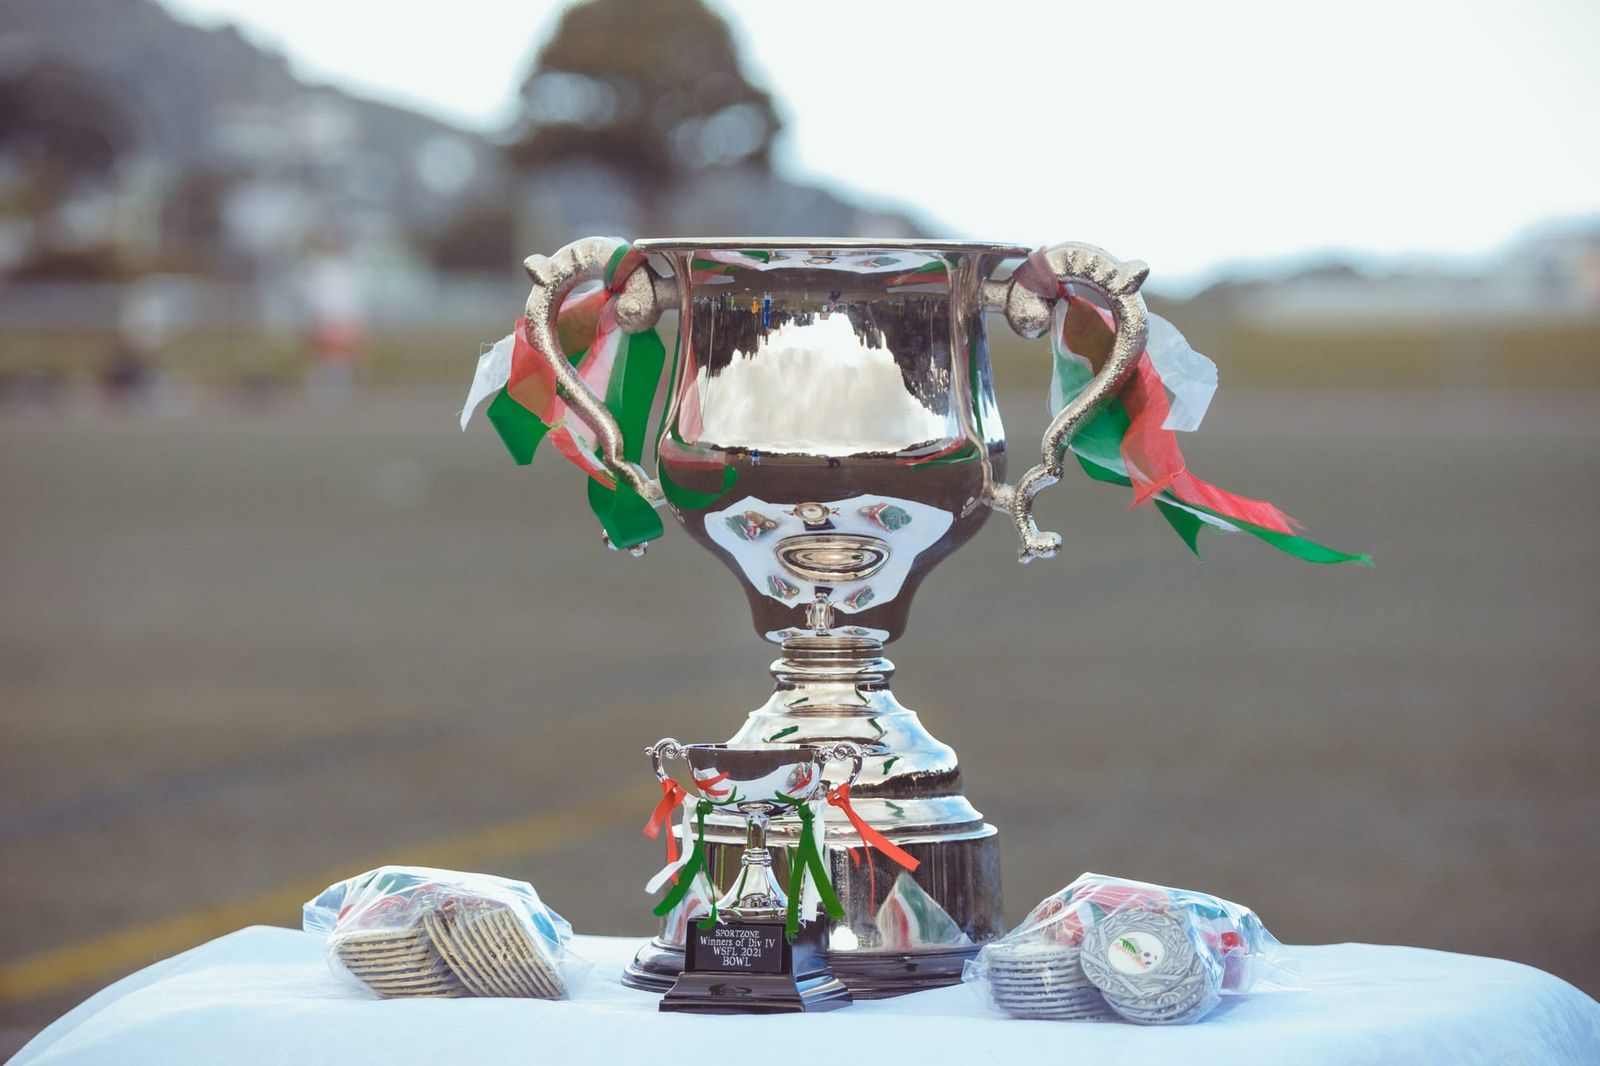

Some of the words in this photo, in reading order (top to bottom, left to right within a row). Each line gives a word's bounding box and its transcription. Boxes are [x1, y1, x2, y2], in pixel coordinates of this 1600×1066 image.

[715, 929, 760, 938] SPORTZONE
[700, 936, 733, 946] Winners
[735, 937, 745, 947] of
[748, 938, 762, 947] Div
[765, 939, 776, 948] IV
[713, 946, 738, 956] WSFL
[741, 947, 761, 957] 2021
[722, 956, 751, 967] BOWL
